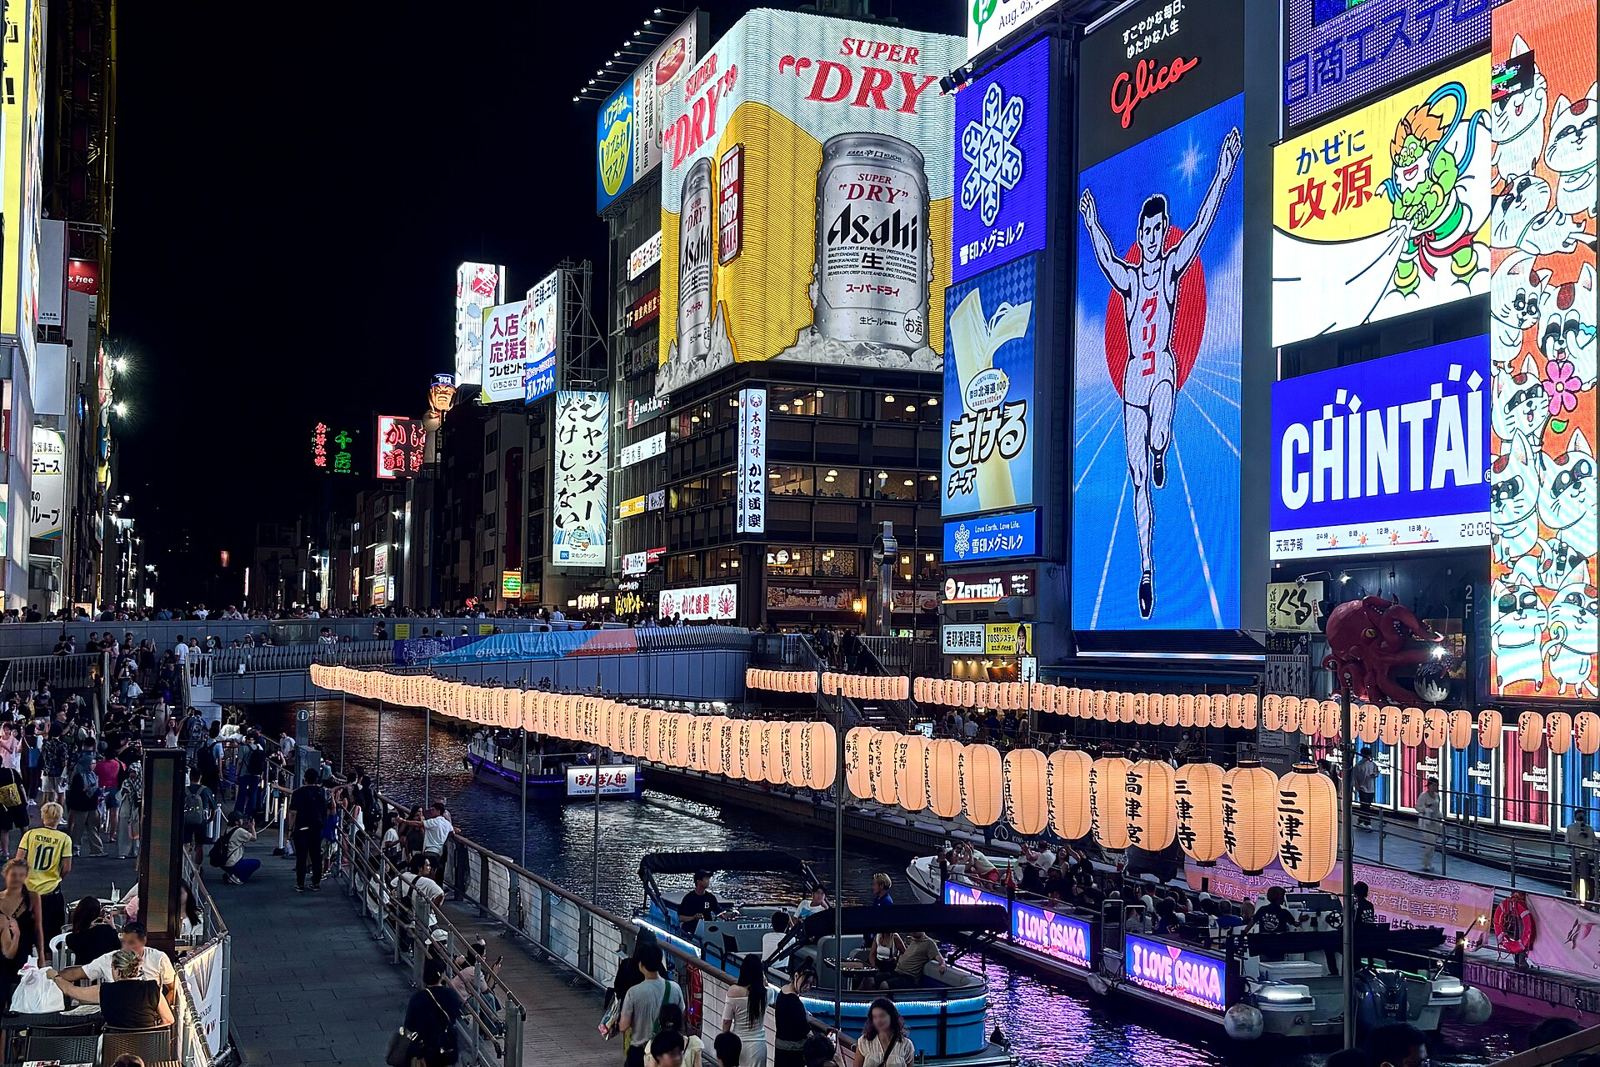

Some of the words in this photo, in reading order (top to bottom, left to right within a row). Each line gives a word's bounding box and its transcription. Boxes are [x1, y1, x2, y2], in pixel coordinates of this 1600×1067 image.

[999, 9, 1019, 30] Aug.
[1123, 0, 1185, 44] すこやかな毎日、
[839, 37, 919, 65] SUPER
[1126, 19, 1179, 59] ゆたかな人生
[684, 53, 718, 103] SUPER
[1110, 57, 1198, 128] Glico
[605, 152, 625, 186] マスク
[1296, 130, 1366, 176] かぜに
[858, 173, 892, 184] SUPER
[1288, 154, 1374, 230] 改源
[828, 203, 918, 253] Asahi
[959, 221, 1025, 266] 雪印メグミルク
[681, 225, 710, 280] Asahi
[861, 252, 885, 270] 生
[75, 275, 94, 284] Free
[690, 269, 698, 285] 生
[846, 284, 901, 297] スーパードライ
[490, 314, 519, 339] 入店
[860, 316, 885, 326] 生ビール
[1140, 292, 1160, 378] グリコ
[334, 430, 352, 468] 千房
[750, 411, 762, 458] 本場の味
[948, 400, 1028, 468] さける
[1281, 364, 1483, 510] CHINTAI
[32, 458, 60, 473] デュース
[556, 397, 580, 529] だけじゃない
[579, 394, 607, 520] シャッター
[947, 468, 977, 499] チーズ
[972, 534, 1024, 554] 雪印メグミルク
[975, 524, 984, 533] Love
[985, 523, 999, 532] Earth.
[1000, 522, 1010, 530] Love
[1010, 520, 1020, 529] Life.
[1276, 538, 1304, 552] 天気予報
[1376, 527, 1389, 535] 12時
[957, 581, 1004, 599] ZETTERIA
[1277, 588, 1312, 625] くくる
[575, 773, 627, 788] ぽんぽん船
[1477, 760, 1490, 770] Street
[1533, 765, 1547, 775] Street
[1125, 771, 1144, 845] 高津宮
[1174, 779, 1197, 851] 三津寺
[1221, 783, 1238, 855] 三津寺
[1277, 790, 1304, 870] 三津寺
[33, 844, 55, 871] 10
[704, 901, 710, 909] B
[1017, 909, 1024, 937] I
[1024, 912, 1049, 947] LOVE
[1049, 922, 1087, 959] OSAKA
[1132, 945, 1142, 976] I
[1143, 949, 1174, 988] LOVE
[1174, 960, 1222, 1002] OSAKA
